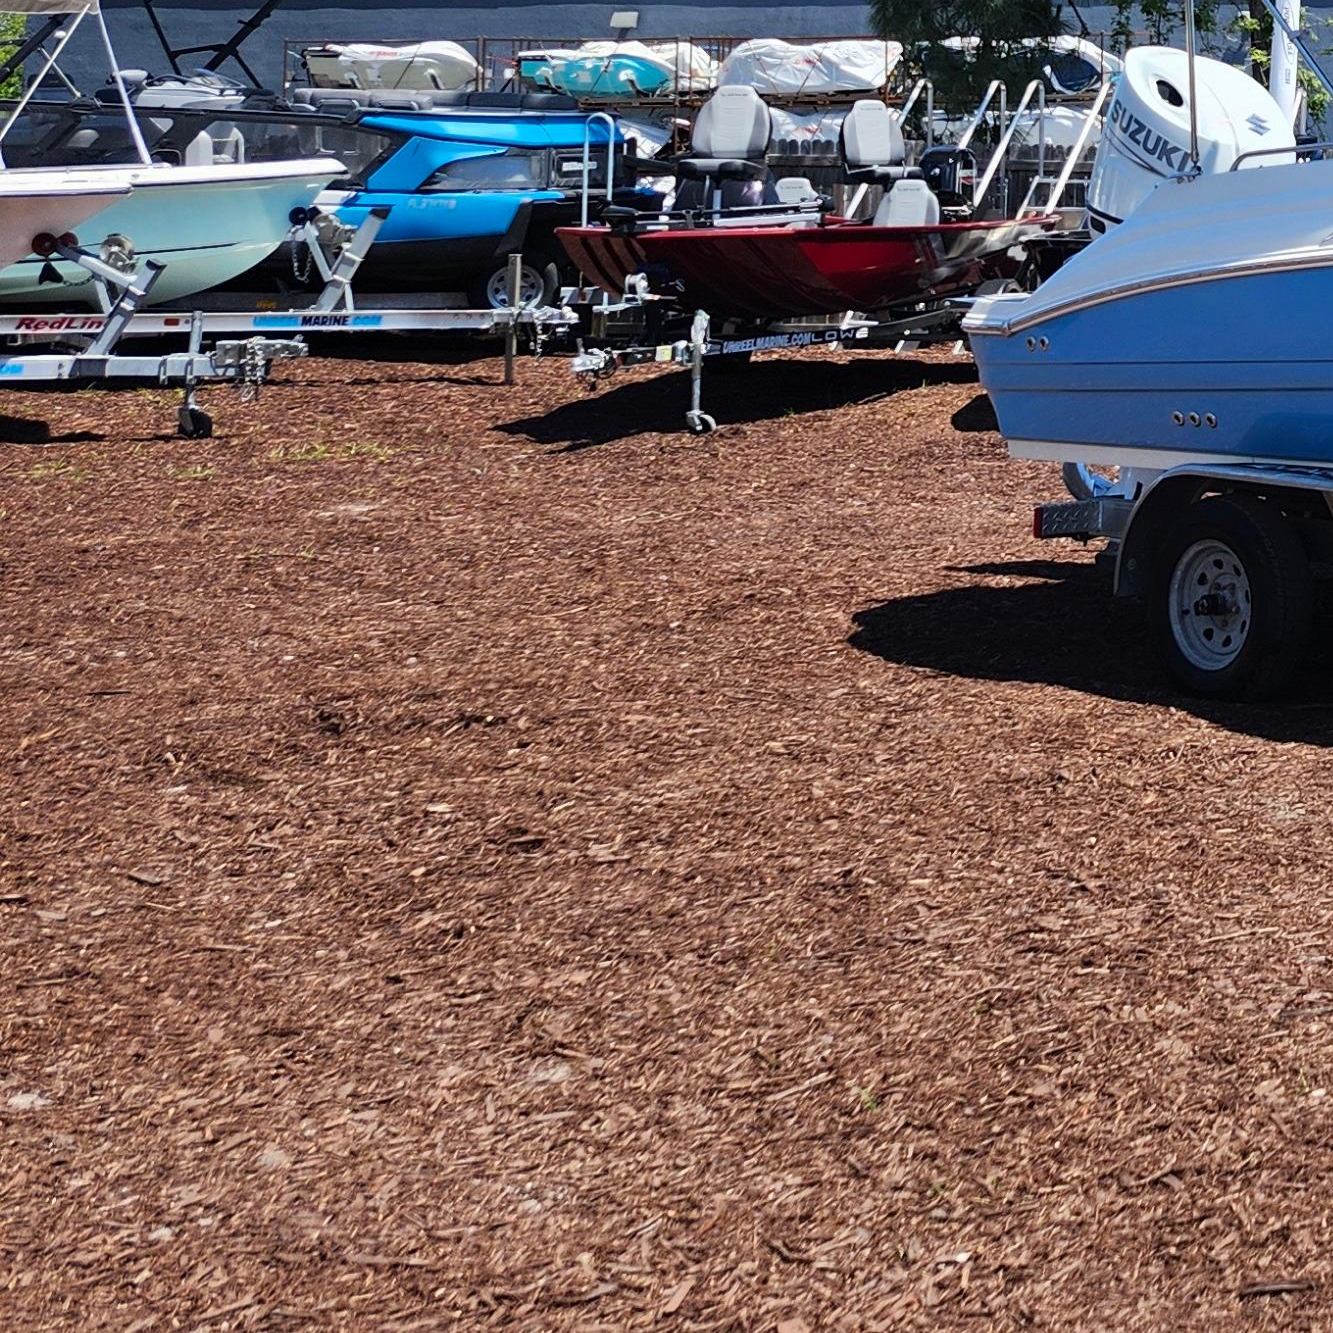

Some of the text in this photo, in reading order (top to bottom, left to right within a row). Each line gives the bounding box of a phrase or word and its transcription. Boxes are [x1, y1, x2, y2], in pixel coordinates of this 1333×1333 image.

[1111, 99, 1191, 172] SUZUKI
[15, 317, 106, 331] RedLin
[811, 327, 869, 342] LOWE
